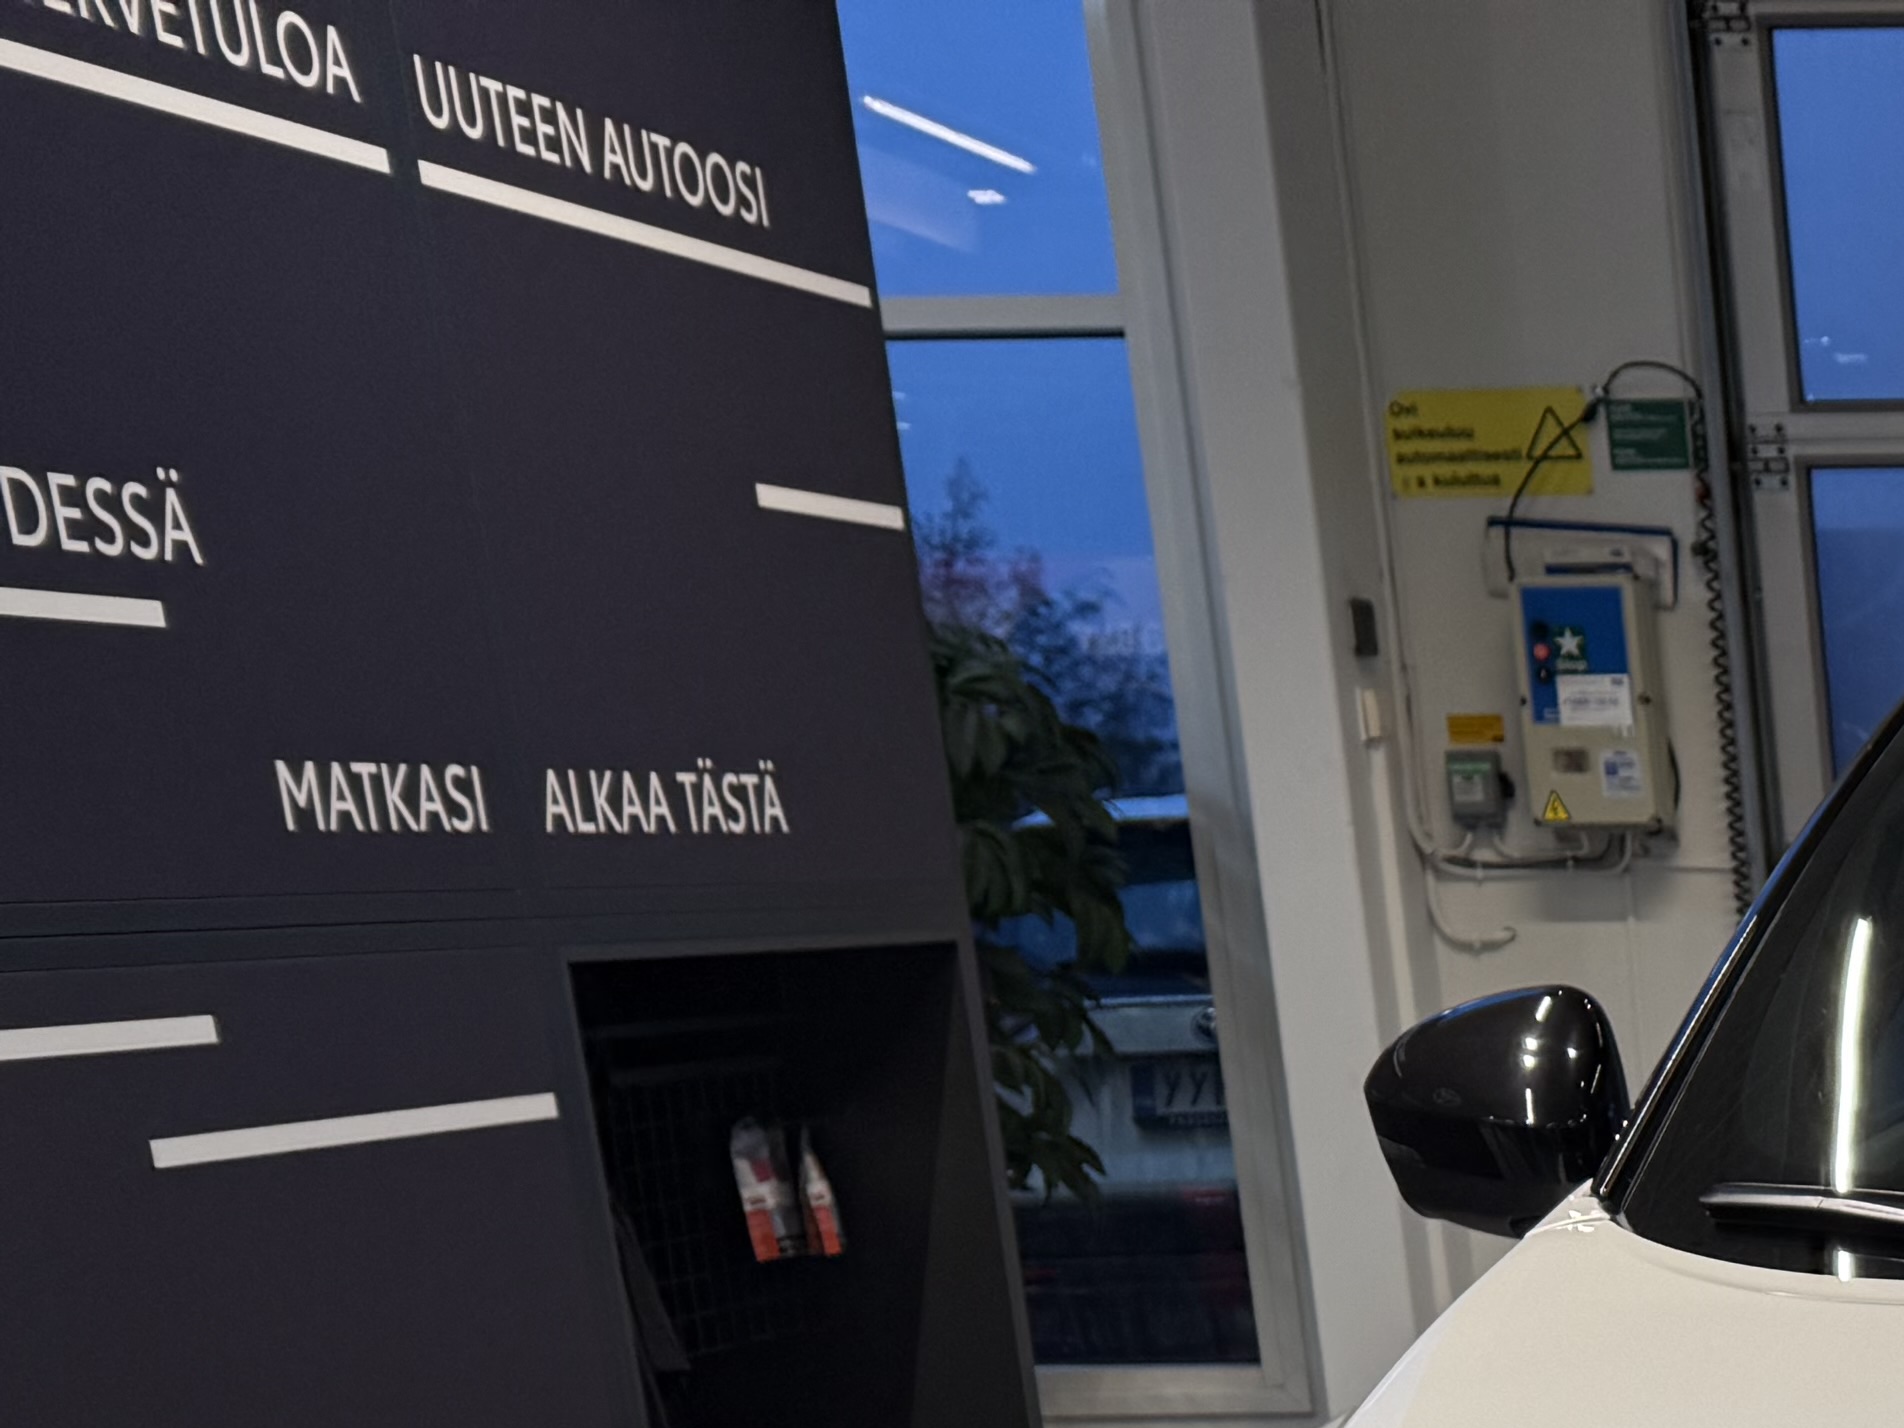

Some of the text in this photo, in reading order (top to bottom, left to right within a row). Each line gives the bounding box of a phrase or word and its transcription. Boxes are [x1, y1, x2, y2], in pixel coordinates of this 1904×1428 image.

[413, 53, 593, 176] UUTEEN
[602, 117, 770, 229] AUTOOSI
[274, 757, 789, 835] MATKASI ALKAA TÄSTÄ
